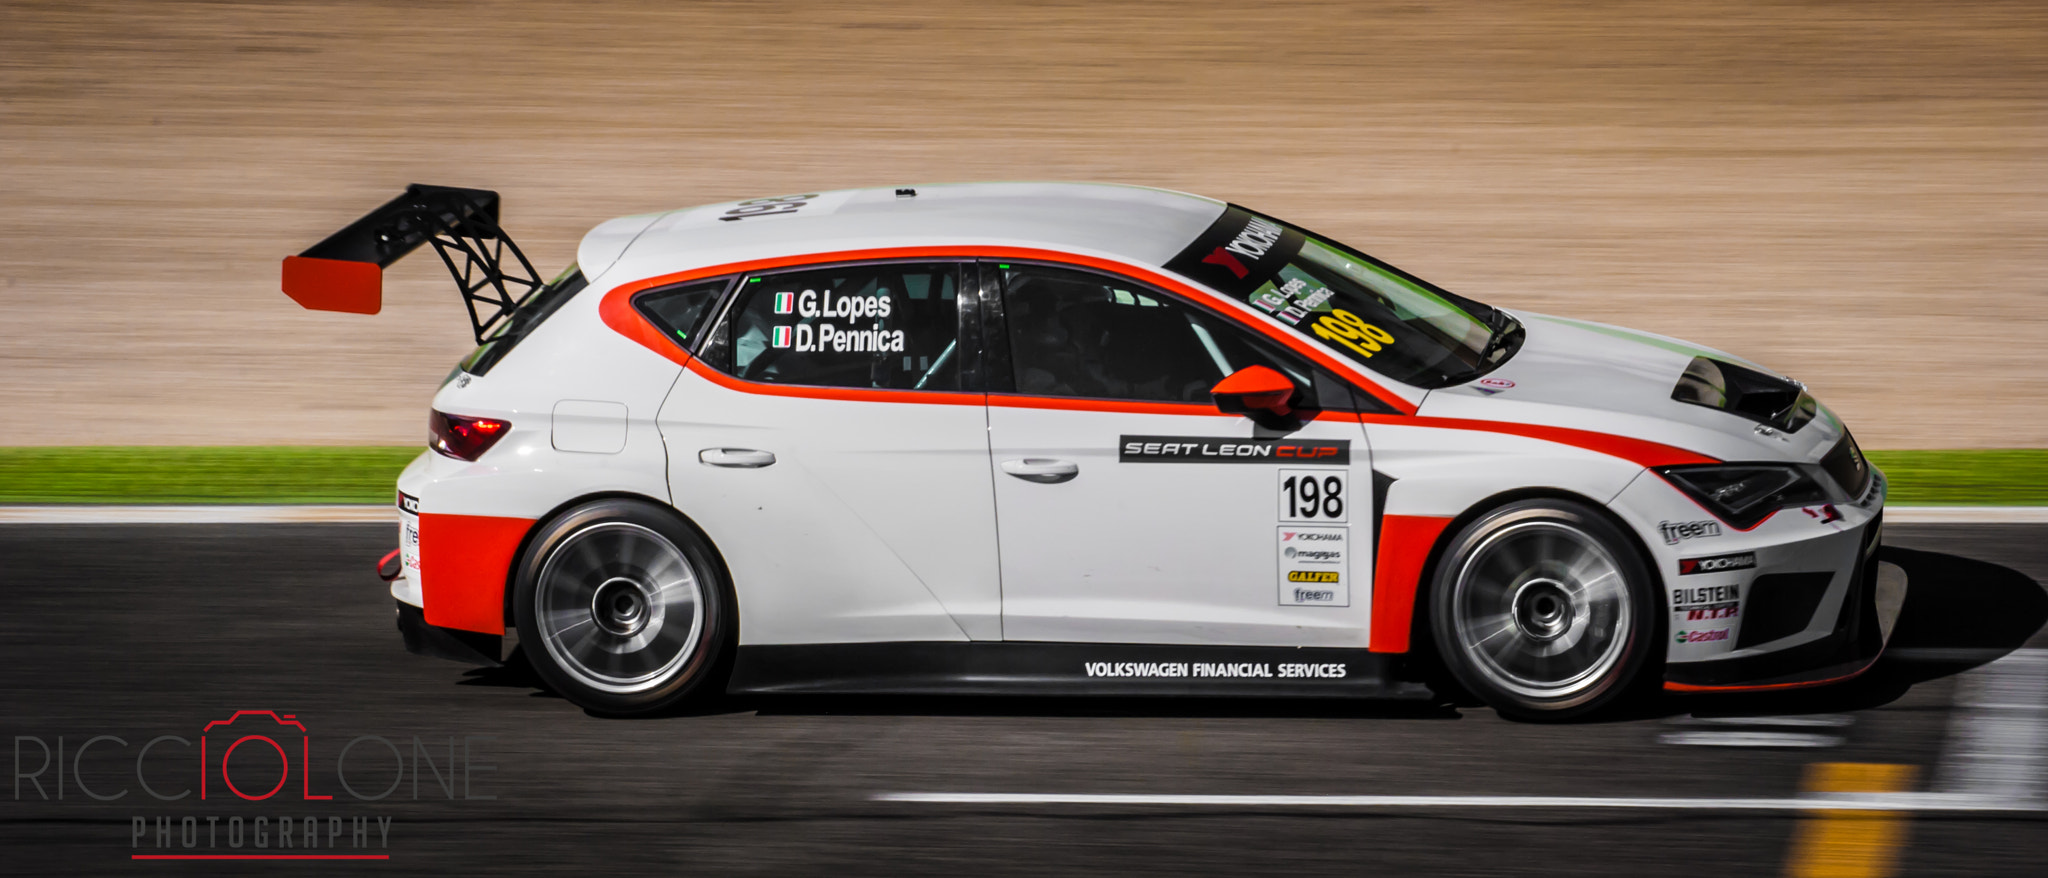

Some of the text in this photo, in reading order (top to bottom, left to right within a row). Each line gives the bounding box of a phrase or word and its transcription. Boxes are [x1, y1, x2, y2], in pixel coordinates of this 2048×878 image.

[1311, 308, 1395, 358] 198
[1124, 442, 1338, 458] SEAT LEON CUP
[1283, 475, 1343, 518] 198
[1659, 520, 1721, 544] freem
[1288, 571, 1339, 583] GALFER
[1294, 588, 1333, 602] freem
[1673, 584, 1739, 604] BILSTEIN
[1688, 628, 1729, 643] Castrol
[1085, 662, 1346, 678] VOLKSWAGEN FINANCIAL SERVICES
